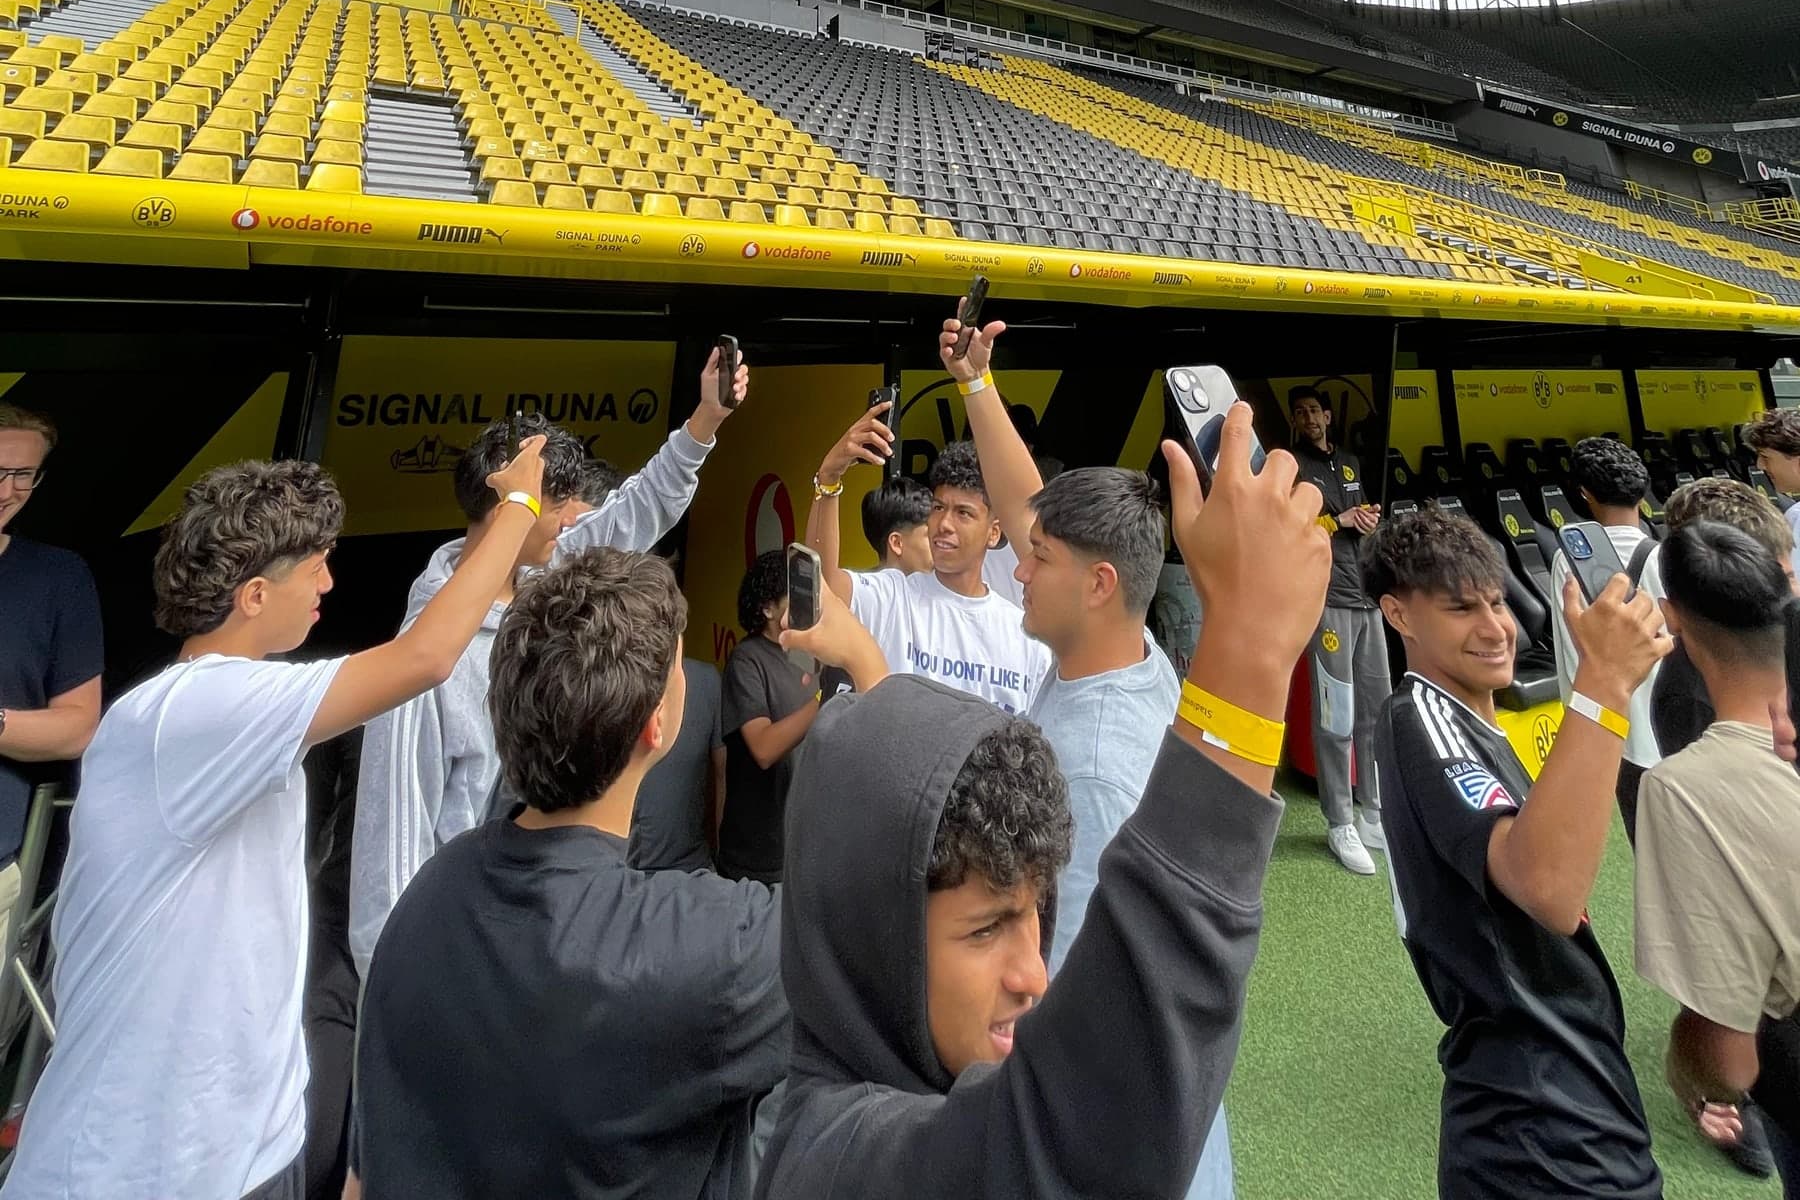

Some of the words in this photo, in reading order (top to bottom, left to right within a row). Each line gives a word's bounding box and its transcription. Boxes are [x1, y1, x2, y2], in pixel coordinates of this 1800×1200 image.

[1582, 120, 1622, 140] SIGNAL
[1624, 131, 1660, 151] IDUNA
[138, 199, 173, 222] BVB
[267, 214, 373, 235] vodafone
[417, 223, 483, 244] PUMA
[555, 230, 595, 242] SIGNAL
[597, 232, 630, 244] IDUNA
[595, 244, 623, 253] PARK
[682, 236, 705, 254] BVB
[764, 246, 832, 261] vodafone
[860, 250, 904, 267] PUMA
[944, 253, 971, 264] SIGNAL
[971, 255, 994, 265] IDUNA
[1027, 258, 1044, 274] BVB
[1085, 266, 1132, 281] vodafone
[1152, 271, 1184, 286] PUMA
[1625, 274, 1643, 284] 41
[1315, 284, 1349, 296] vodafone
[1394, 386, 1419, 400] PUMA
[1534, 374, 1551, 398] BVB
[336, 392, 492, 427] SIGNAL
[505, 392, 619, 423] IDUNA
[914, 647, 938, 673] YOU
[942, 657, 985, 682] DONT
[989, 665, 1021, 691] LIKE
